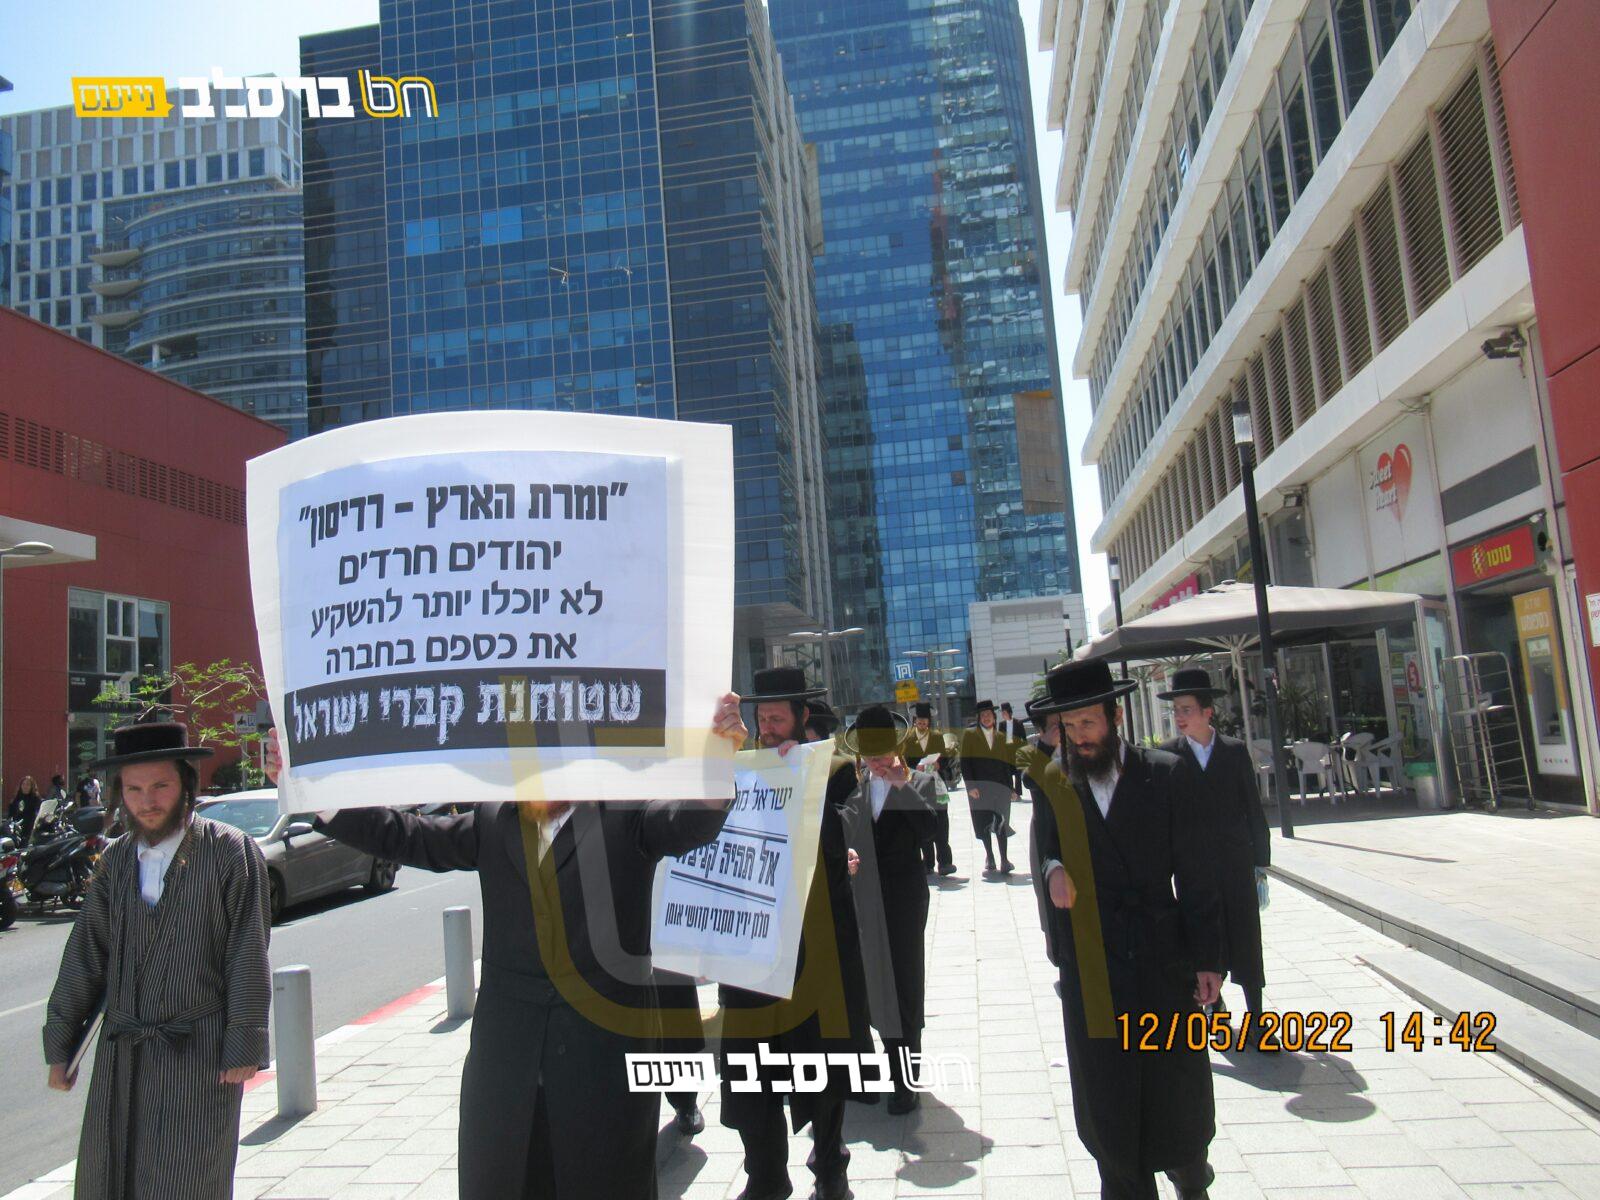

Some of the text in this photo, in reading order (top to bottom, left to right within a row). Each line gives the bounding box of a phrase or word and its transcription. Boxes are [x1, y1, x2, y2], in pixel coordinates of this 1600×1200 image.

[427, 483, 515, 528] הארץ
[339, 540, 562, 585] יהודים חרדים
[311, 580, 603, 638] לא יוכלו יותר להשקיע
[326, 632, 577, 675] את כספם בחברה
[292, 689, 369, 744] ישראל
[378, 680, 465, 744] קברי
[751, 781, 793, 812] ישראל
[719, 842, 756, 881] תהיה
[758, 837, 780, 887] אל
[665, 902, 684, 927] אומן
